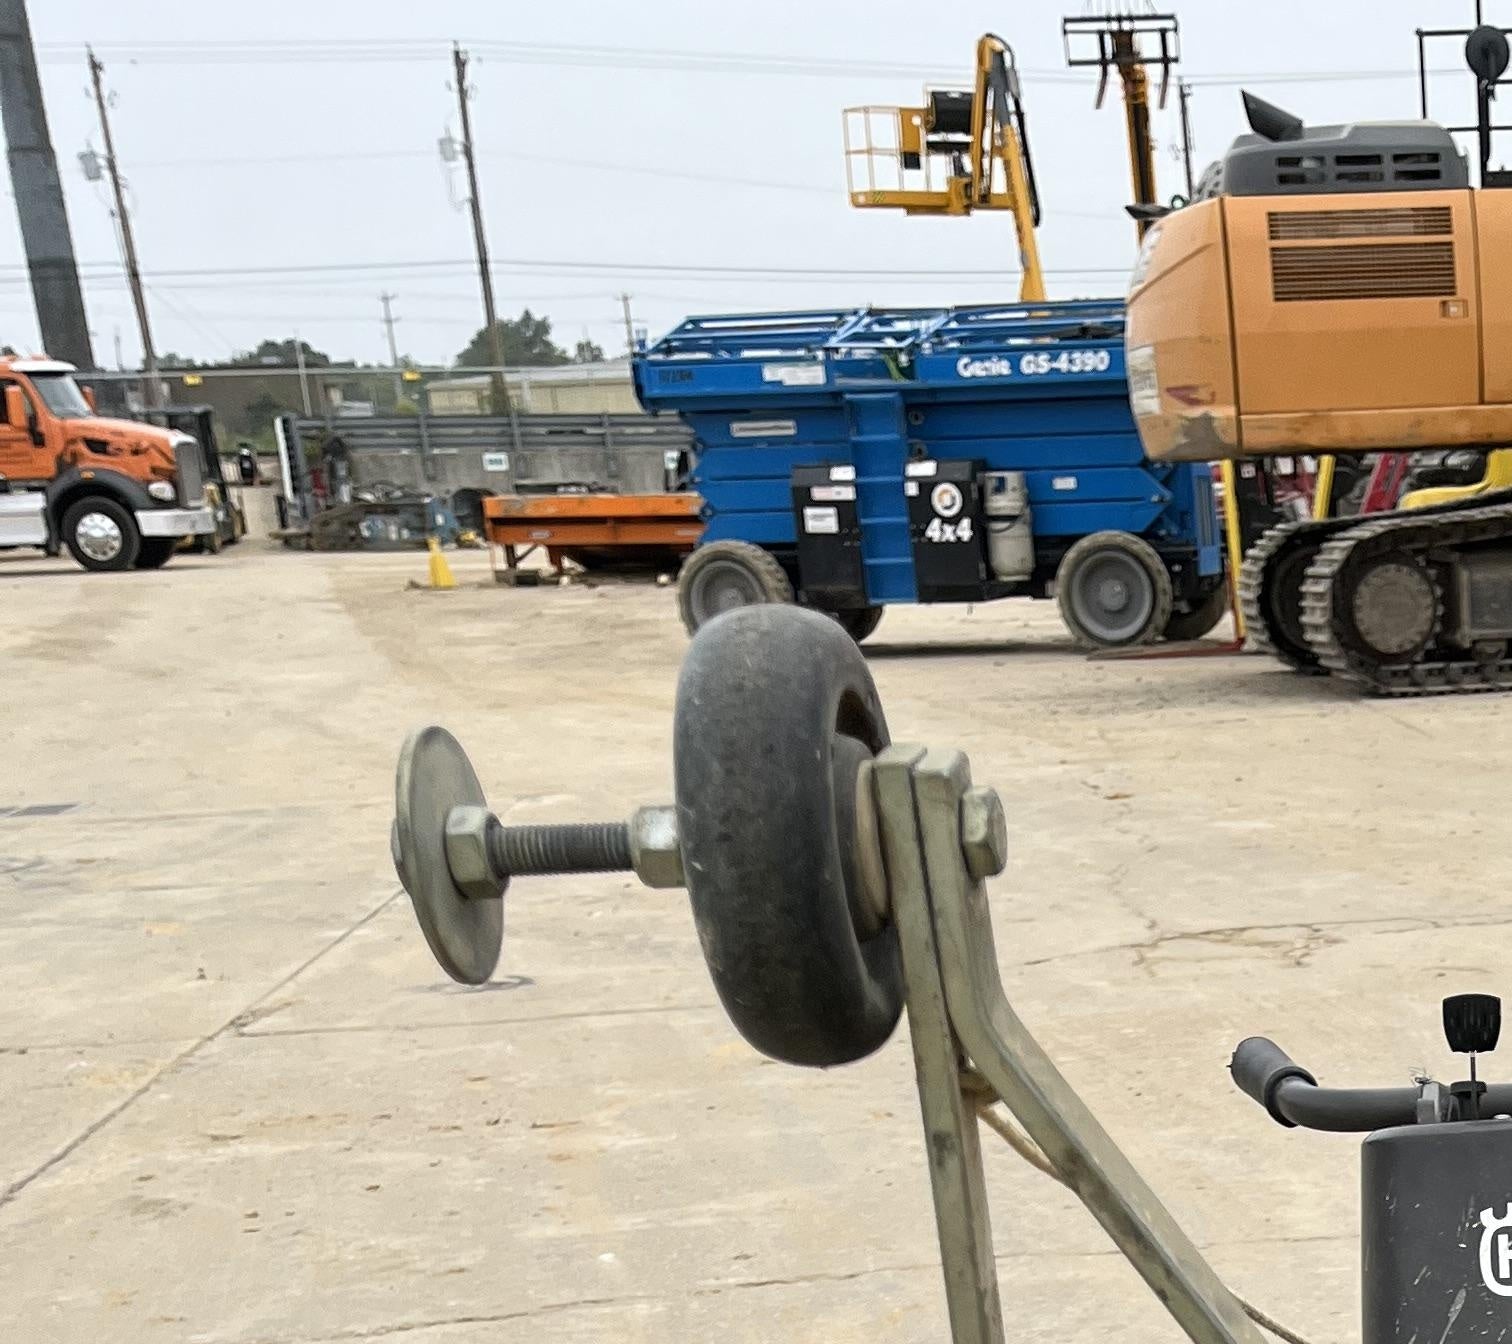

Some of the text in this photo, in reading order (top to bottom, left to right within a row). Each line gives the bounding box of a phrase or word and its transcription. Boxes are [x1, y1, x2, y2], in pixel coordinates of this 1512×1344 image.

[956, 350, 1111, 378] Genie GS-4390
[924, 516, 974, 543] 4x4
